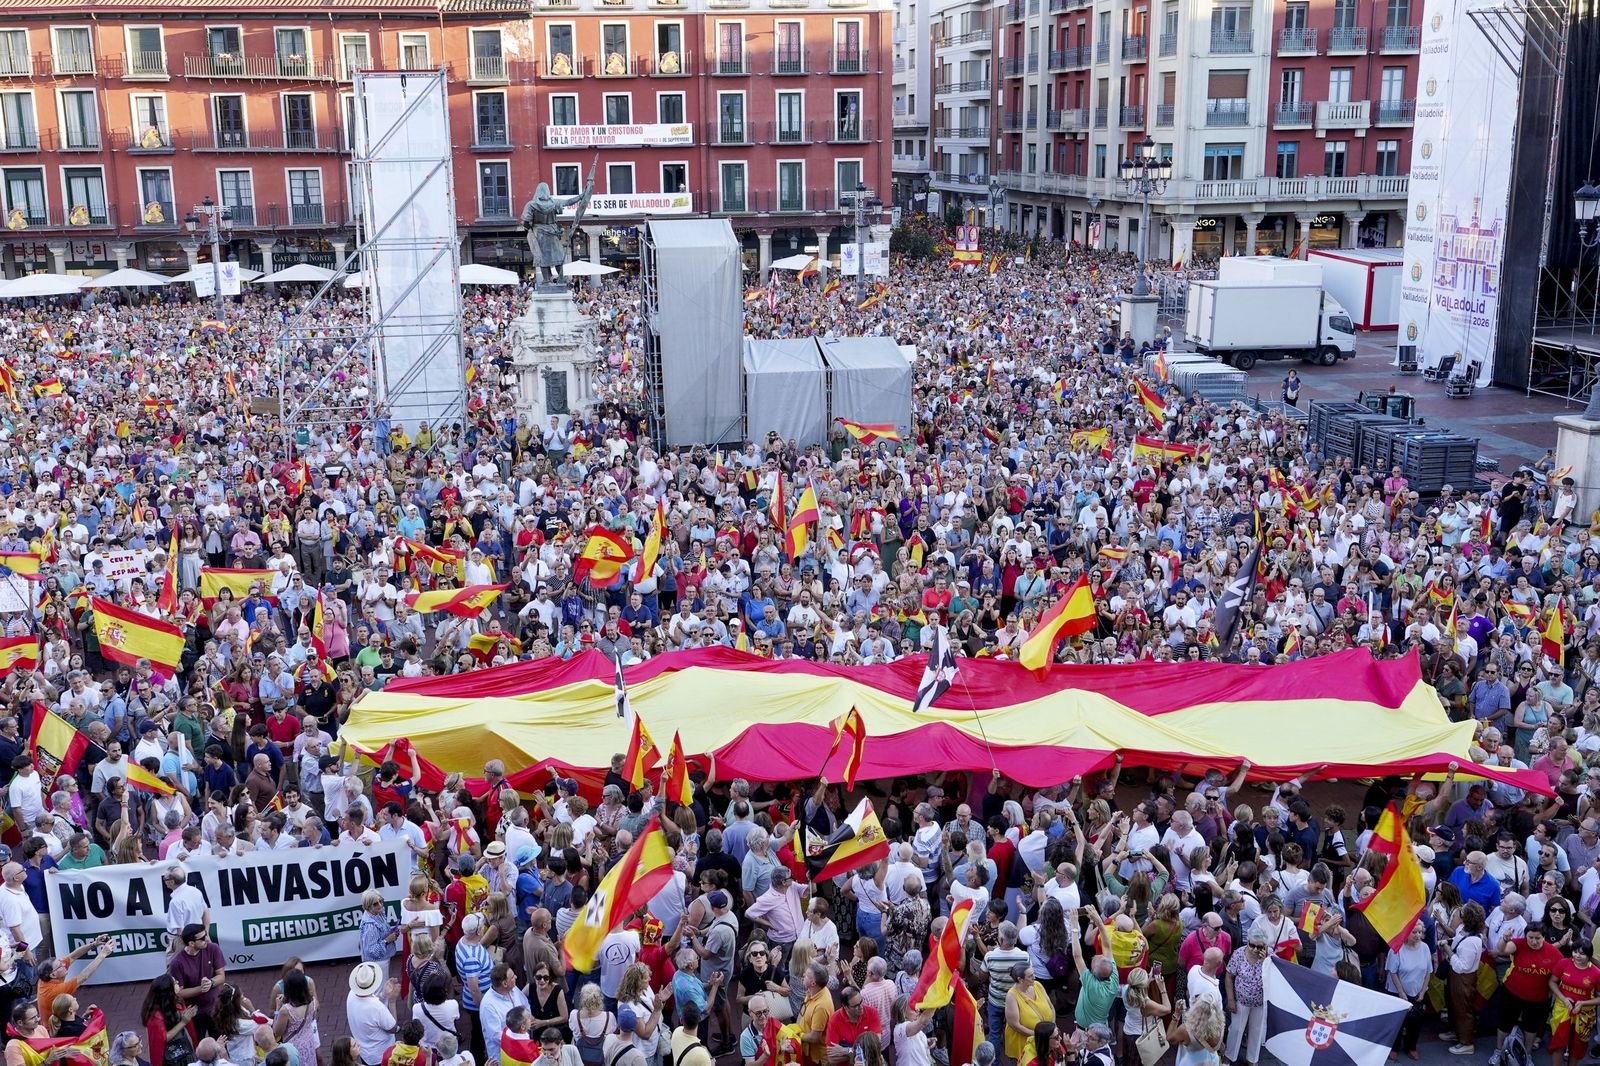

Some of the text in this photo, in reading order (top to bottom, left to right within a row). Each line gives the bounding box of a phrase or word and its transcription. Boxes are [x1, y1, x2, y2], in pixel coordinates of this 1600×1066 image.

[550, 127, 562, 136] PAZ
[564, 127, 569, 135] Y
[570, 127, 589, 135] AMOR
[591, 127, 596, 135] Y
[597, 127, 606, 135] UN
[550, 135, 616, 144] EN LA PLAZA MAYOR
[593, 200, 602, 209] ES
[603, 200, 617, 209] SER
[618, 199, 628, 208] DE
[629, 199, 670, 209] VALLADOLID
[1402, 292, 1428, 303] Valladolid
[1472, 316, 1489, 327] 2026
[58, 880, 115, 920] NO
[126, 877, 153, 917] A
[218, 851, 399, 907] INVASIÓN
[248, 905, 398, 943] DEFIENDE ESPA
[73, 932, 157, 956] DEENDE
[229, 953, 255, 964] VOX
